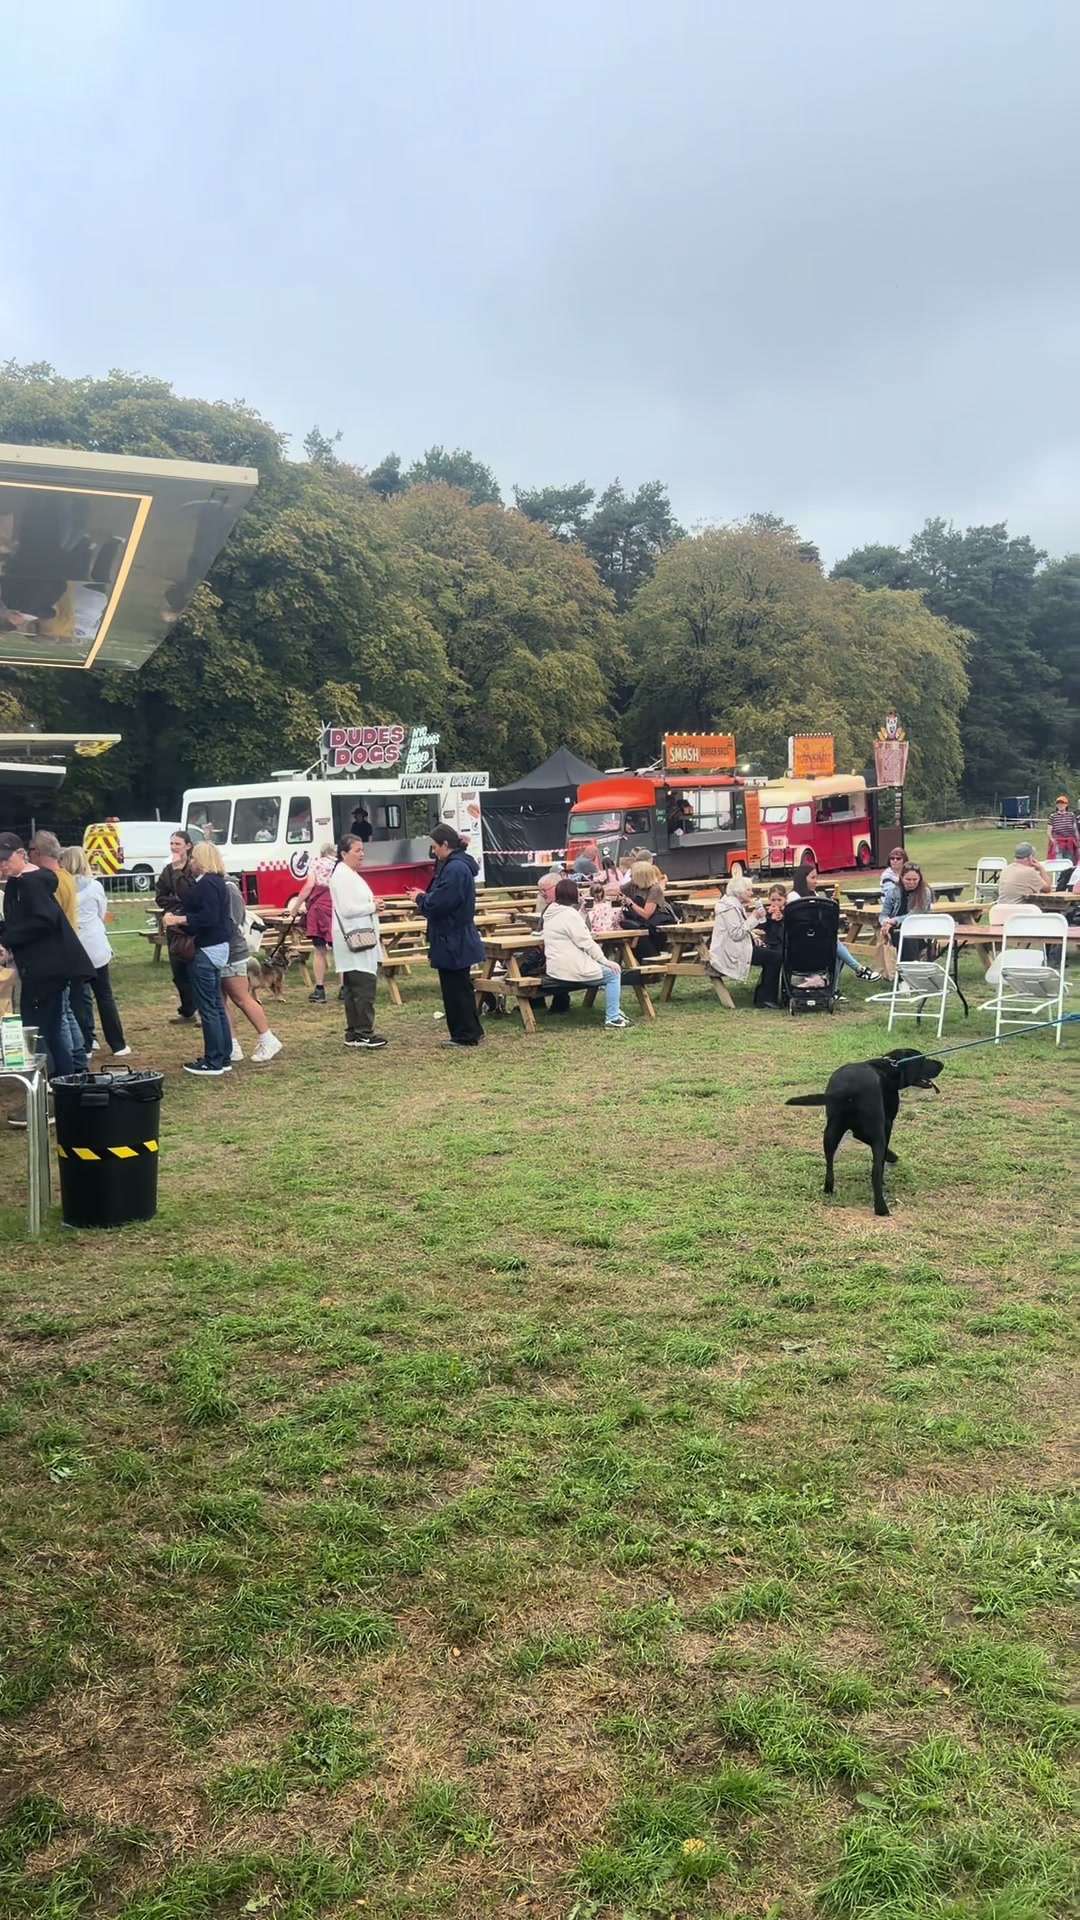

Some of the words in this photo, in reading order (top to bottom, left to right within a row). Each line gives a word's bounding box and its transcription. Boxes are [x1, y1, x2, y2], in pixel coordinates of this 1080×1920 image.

[331, 726, 404, 747] DUDES
[335, 745, 399, 767] DOGS
[669, 747, 699, 763] SMASH
[700, 747, 717, 756] BURGER
